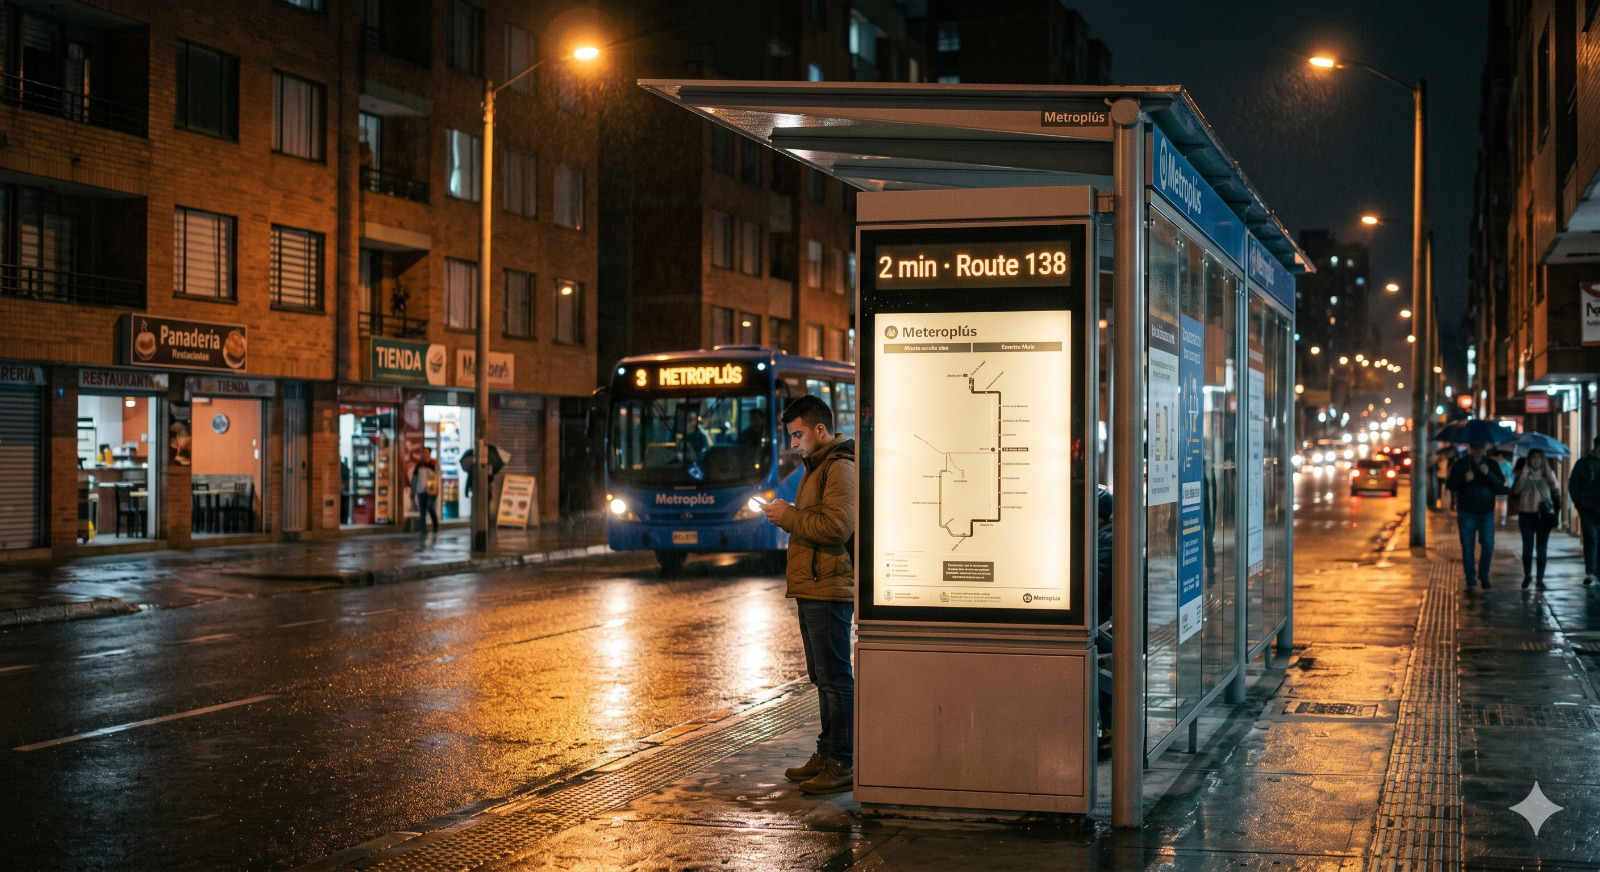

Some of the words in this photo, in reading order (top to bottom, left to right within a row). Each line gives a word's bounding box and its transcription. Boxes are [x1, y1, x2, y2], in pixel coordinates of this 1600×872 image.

[1044, 111, 1105, 124] Metroplús
[1168, 152, 1202, 214] Metroplús
[879, 256, 893, 279] 2
[898, 255, 937, 278] min
[956, 254, 1019, 277] Route
[1025, 251, 1067, 275] 138
[160, 325, 221, 349] Panadería
[902, 325, 977, 339] Meteroplús
[376, 346, 422, 371] TIENDA
[1, 366, 35, 381] RERIA
[636, 369, 647, 386] 3
[659, 363, 743, 385] METROPLÚS
[217, 380, 250, 393] TIENDA
[655, 492, 715, 507] Metroplús
